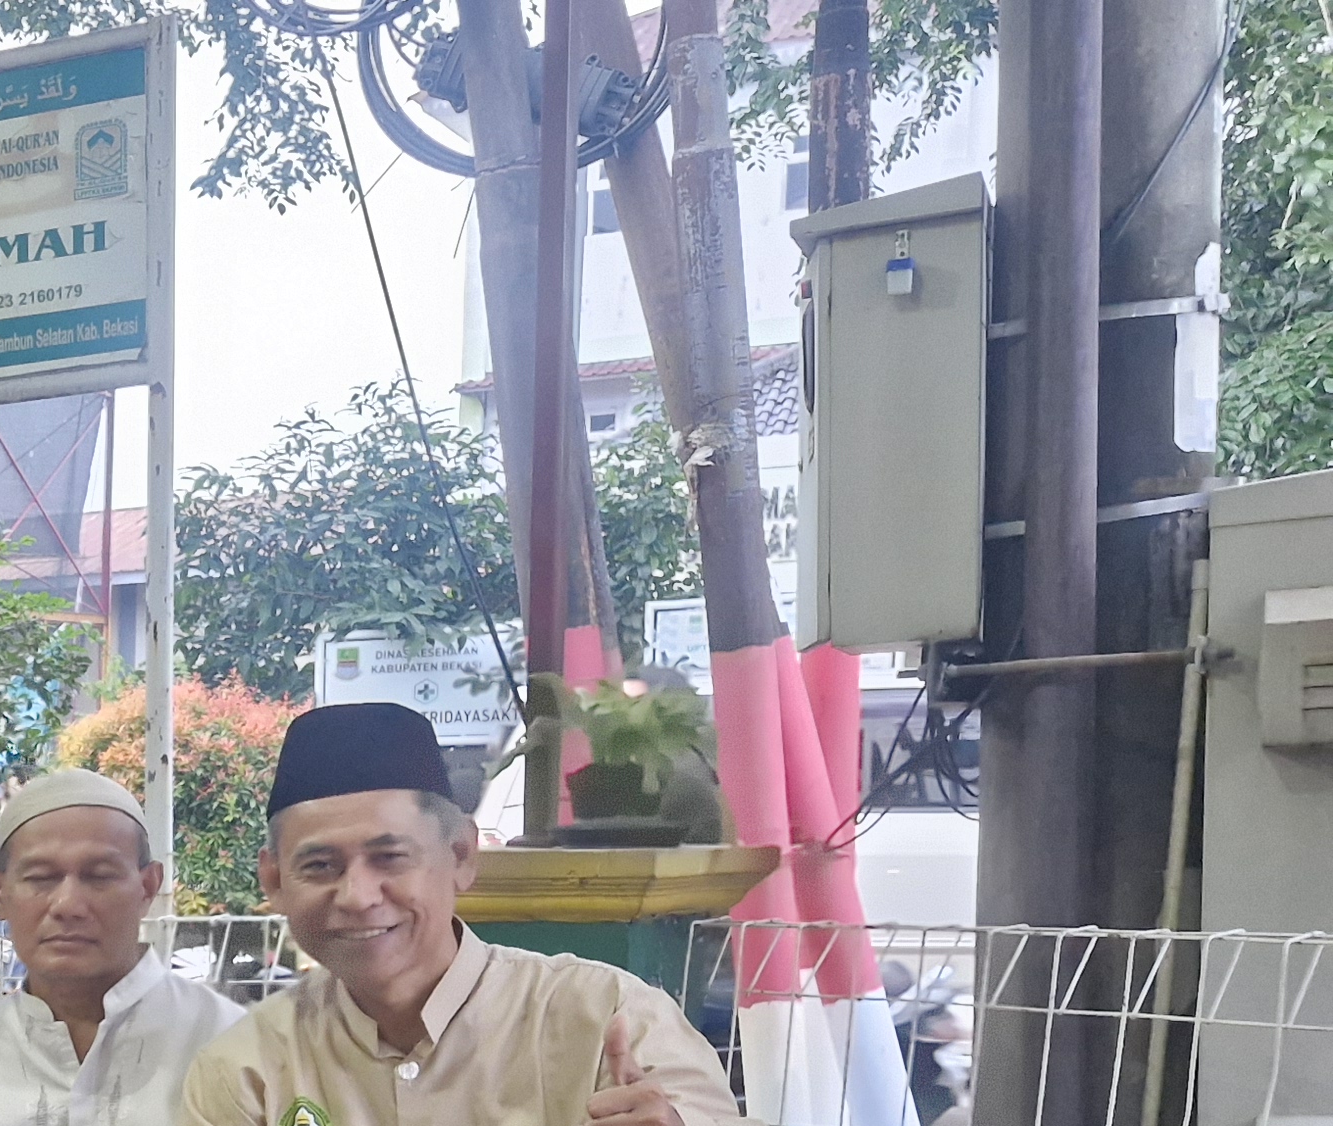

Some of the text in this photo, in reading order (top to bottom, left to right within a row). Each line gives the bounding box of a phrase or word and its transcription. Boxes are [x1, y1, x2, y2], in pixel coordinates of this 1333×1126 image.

[18, 283, 83, 306] 2160179
[36, 326, 74, 348] Selatan
[76, 323, 101, 342] Kab.
[103, 318, 139, 338] Bekasi
[371, 662, 438, 674] KABUPATEN
